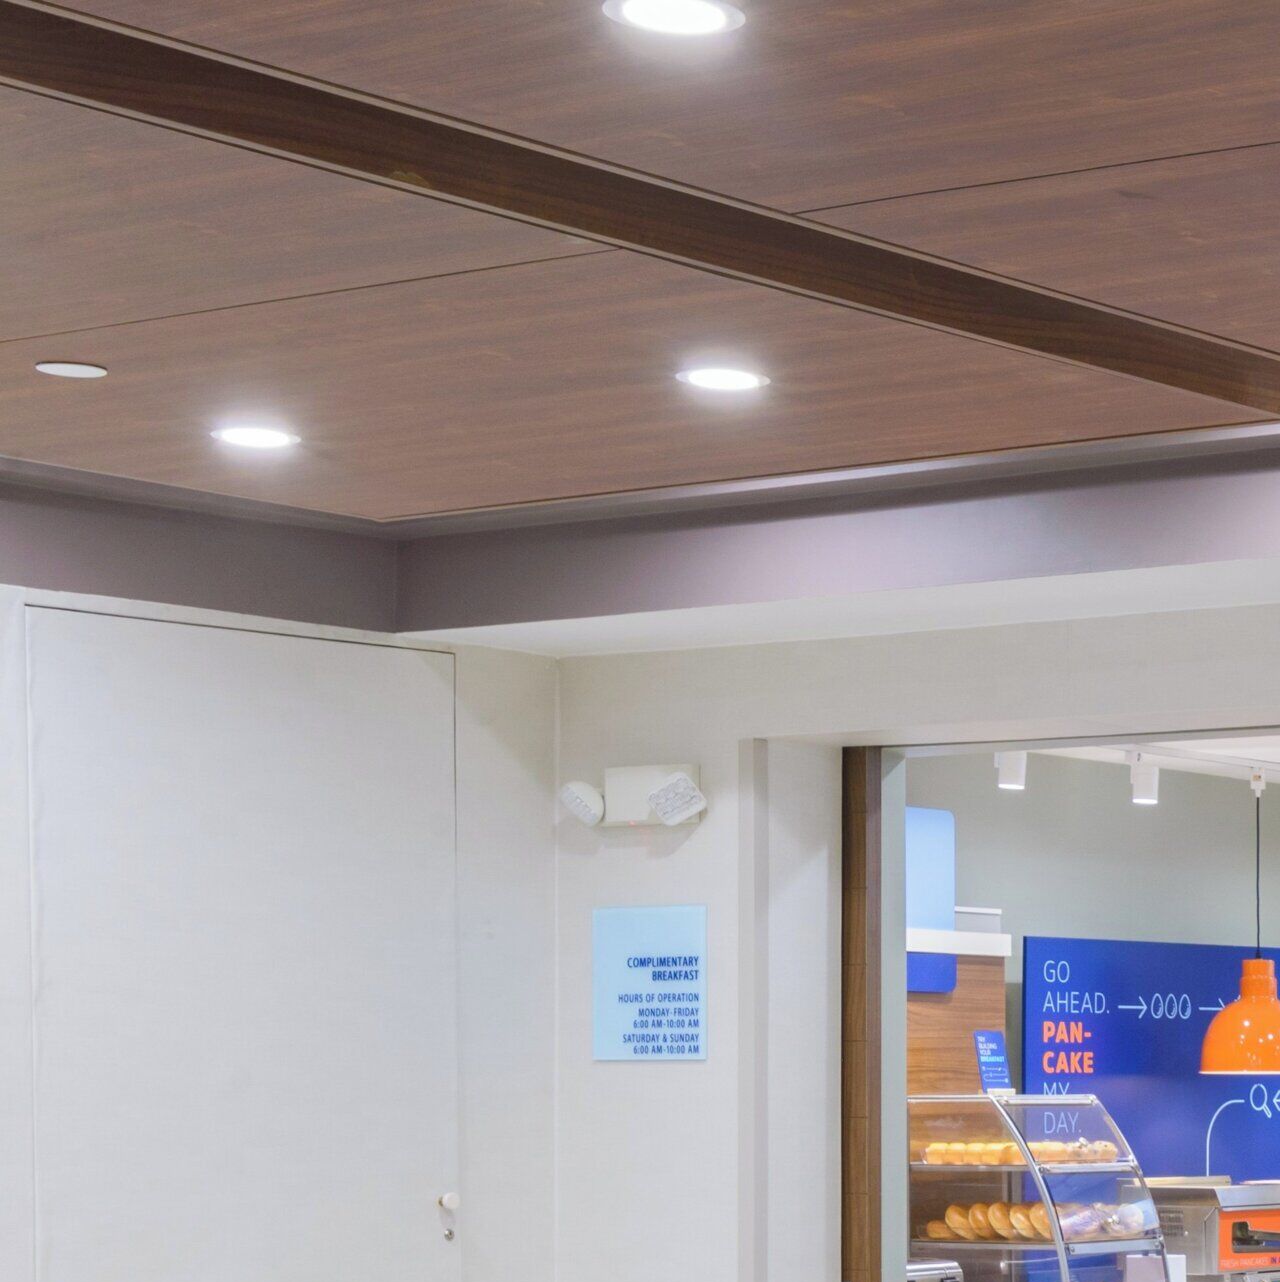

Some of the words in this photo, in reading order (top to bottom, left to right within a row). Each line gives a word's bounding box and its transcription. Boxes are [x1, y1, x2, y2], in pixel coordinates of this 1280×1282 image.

[627, 956, 699, 968] COMPLIMENTARY
[652, 970, 699, 981] BREAKFAST
[1043, 960, 1070, 983] GO
[618, 993, 643, 1003] HOURS
[645, 993, 656, 1003] OF
[658, 993, 699, 1002] OPERATION
[1042, 991, 1110, 1014] AHEAD.
[633, 1020, 649, 1029] 6:00
[688, 1019, 700, 1028] AM
[1042, 1021, 1092, 1044] PAN-
[623, 1034, 660, 1043] SATURDAY
[662, 1034, 668, 1043] &
[670, 1034, 699, 1043] SUNDAY
[633, 1045, 649, 1054] 6:00
[688, 1045, 700, 1054] AM
[1042, 1051, 1094, 1074] CAKE
[1044, 1112, 1082, 1134] DAY.
[1270, 1256, 1277, 1264] IN
